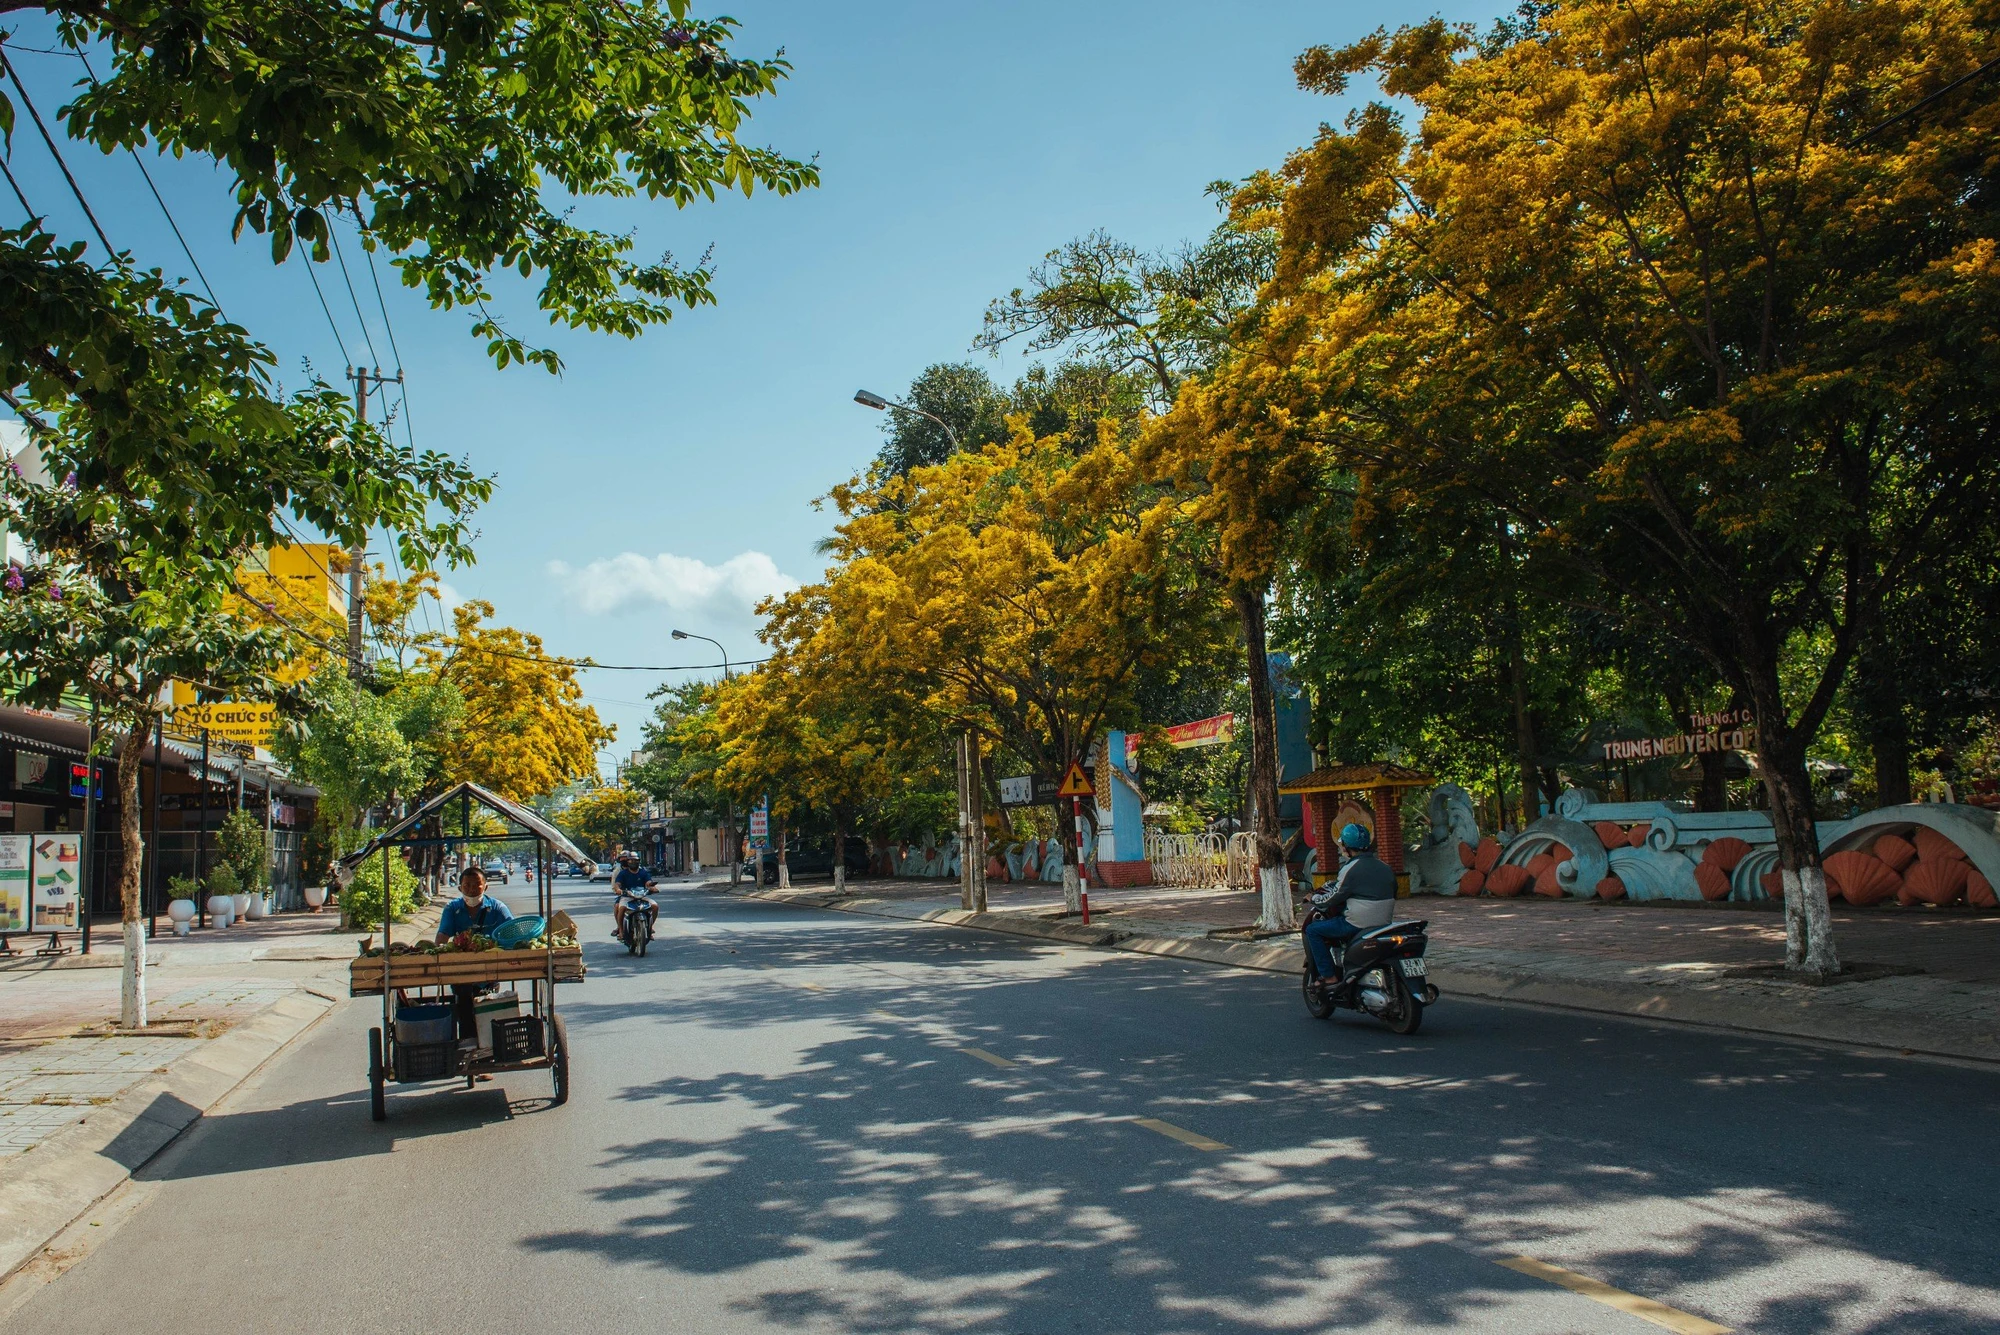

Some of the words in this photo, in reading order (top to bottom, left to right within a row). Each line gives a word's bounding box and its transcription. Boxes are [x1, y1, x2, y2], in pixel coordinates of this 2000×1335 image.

[215, 708, 256, 723] CHỨC
[1690, 714, 1711, 728] The
[1603, 739, 1652, 760] TRUNG
[1653, 730, 1719, 756] NGUYÊN
